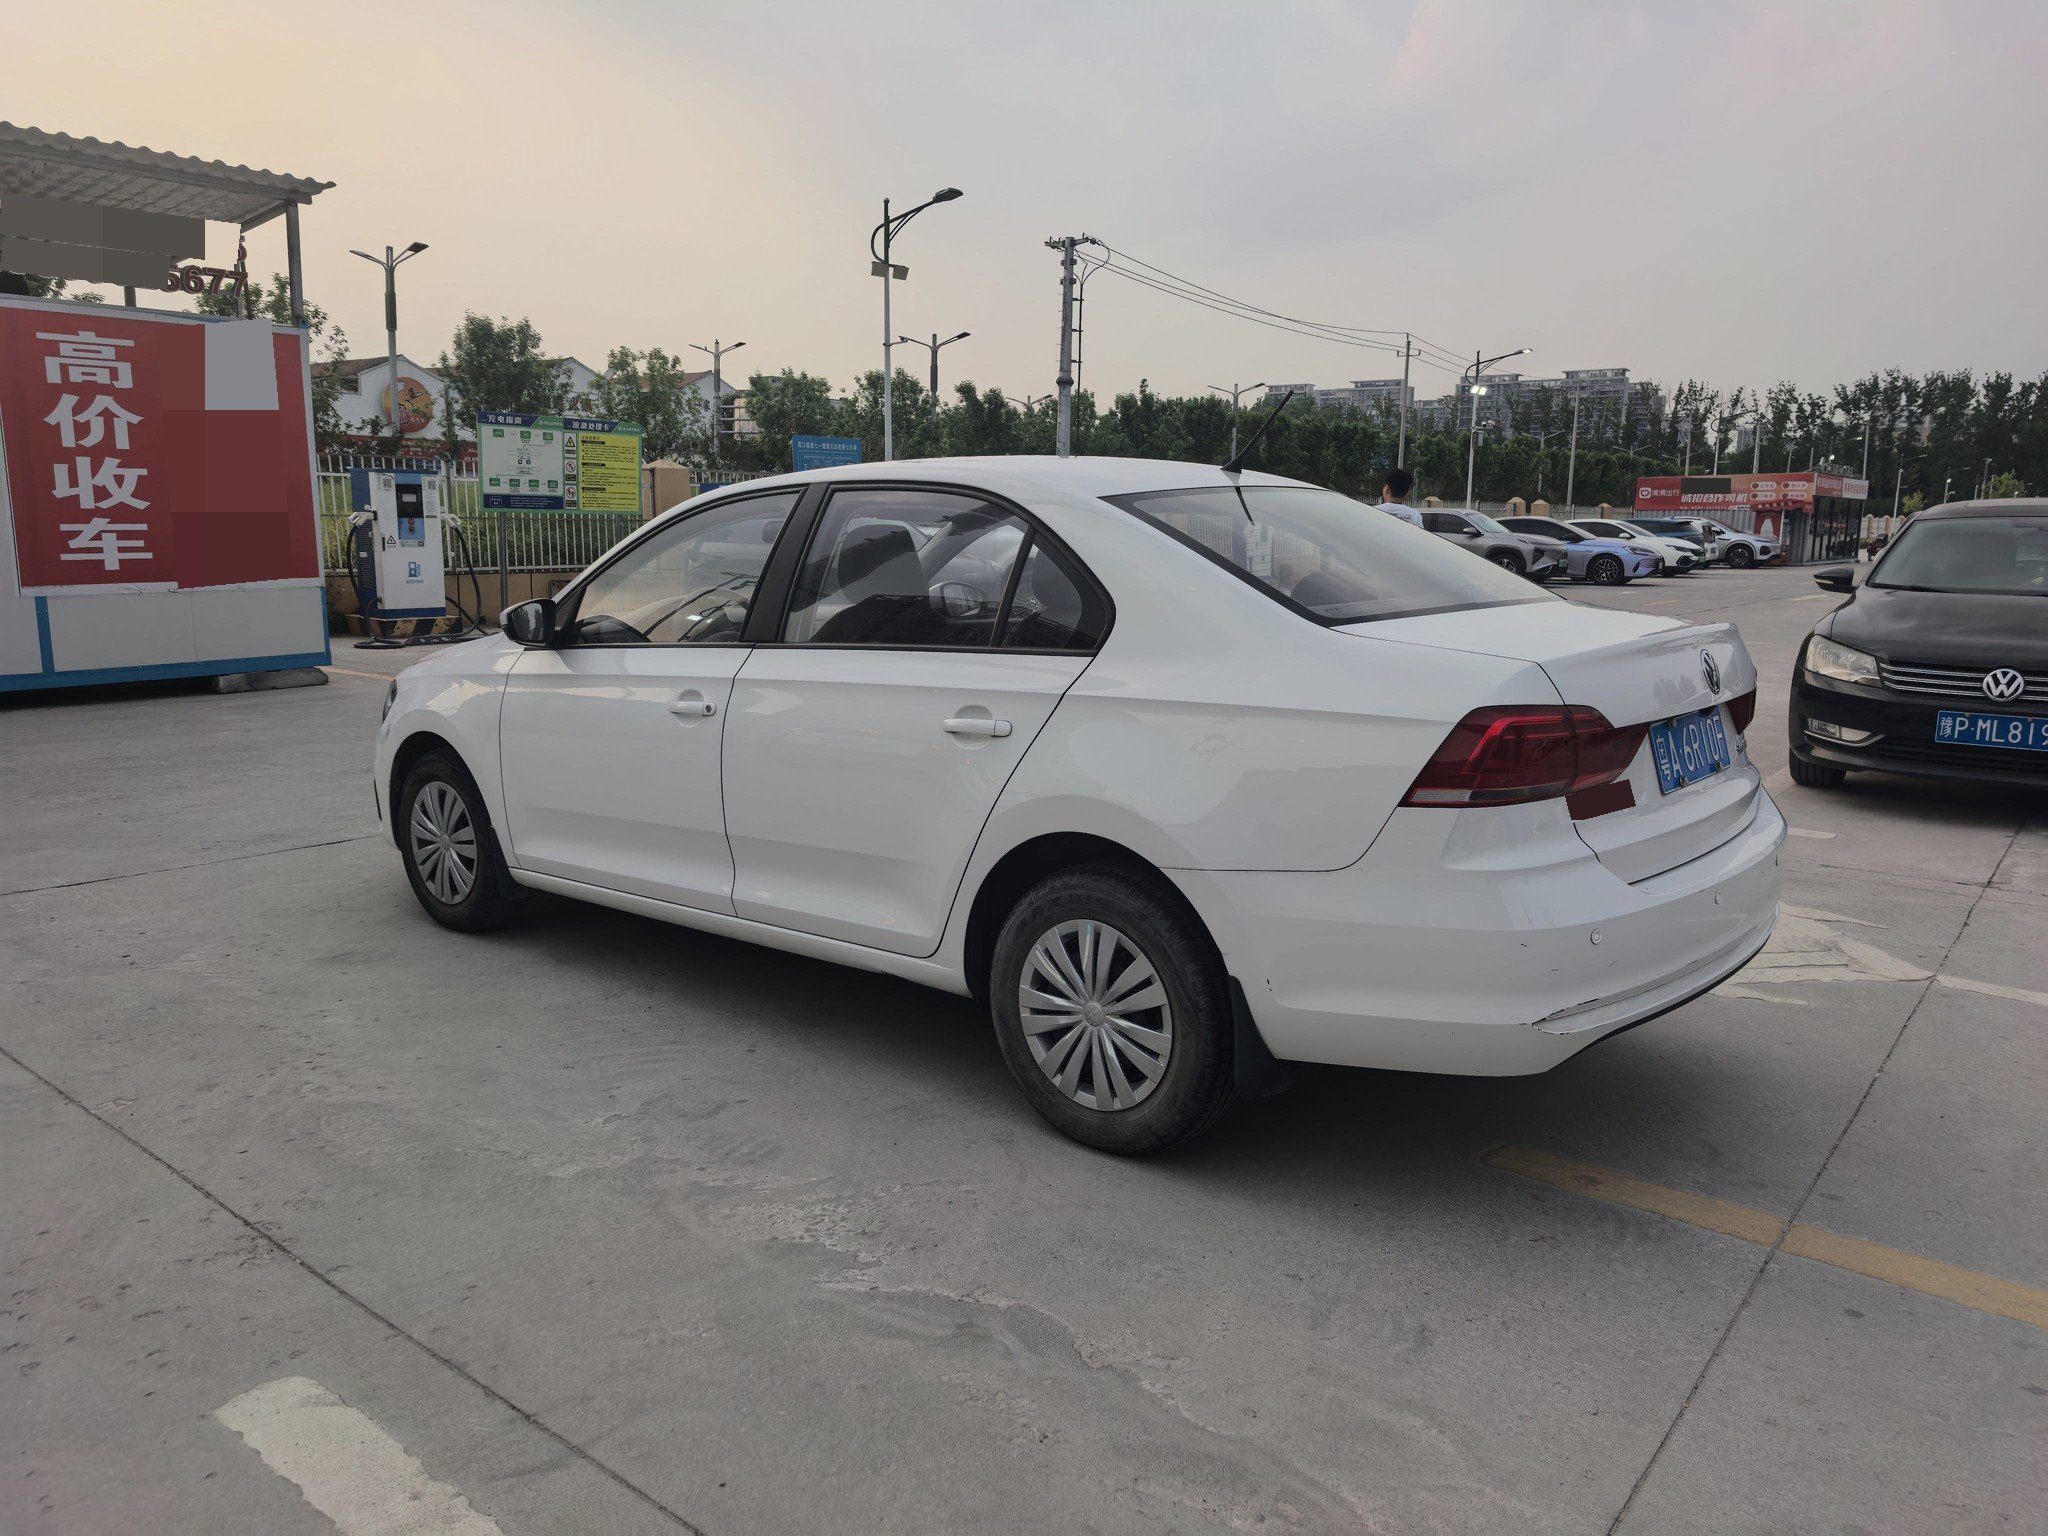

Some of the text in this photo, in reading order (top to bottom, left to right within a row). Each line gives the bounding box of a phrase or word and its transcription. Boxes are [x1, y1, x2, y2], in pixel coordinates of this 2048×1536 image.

[487, 414, 522, 425] 充电指南
[36, 330, 153, 571] 高价收车
[1651, 488, 1680, 497] 滴滴出行
[1680, 493, 1748, 503] 诚招合作司机
